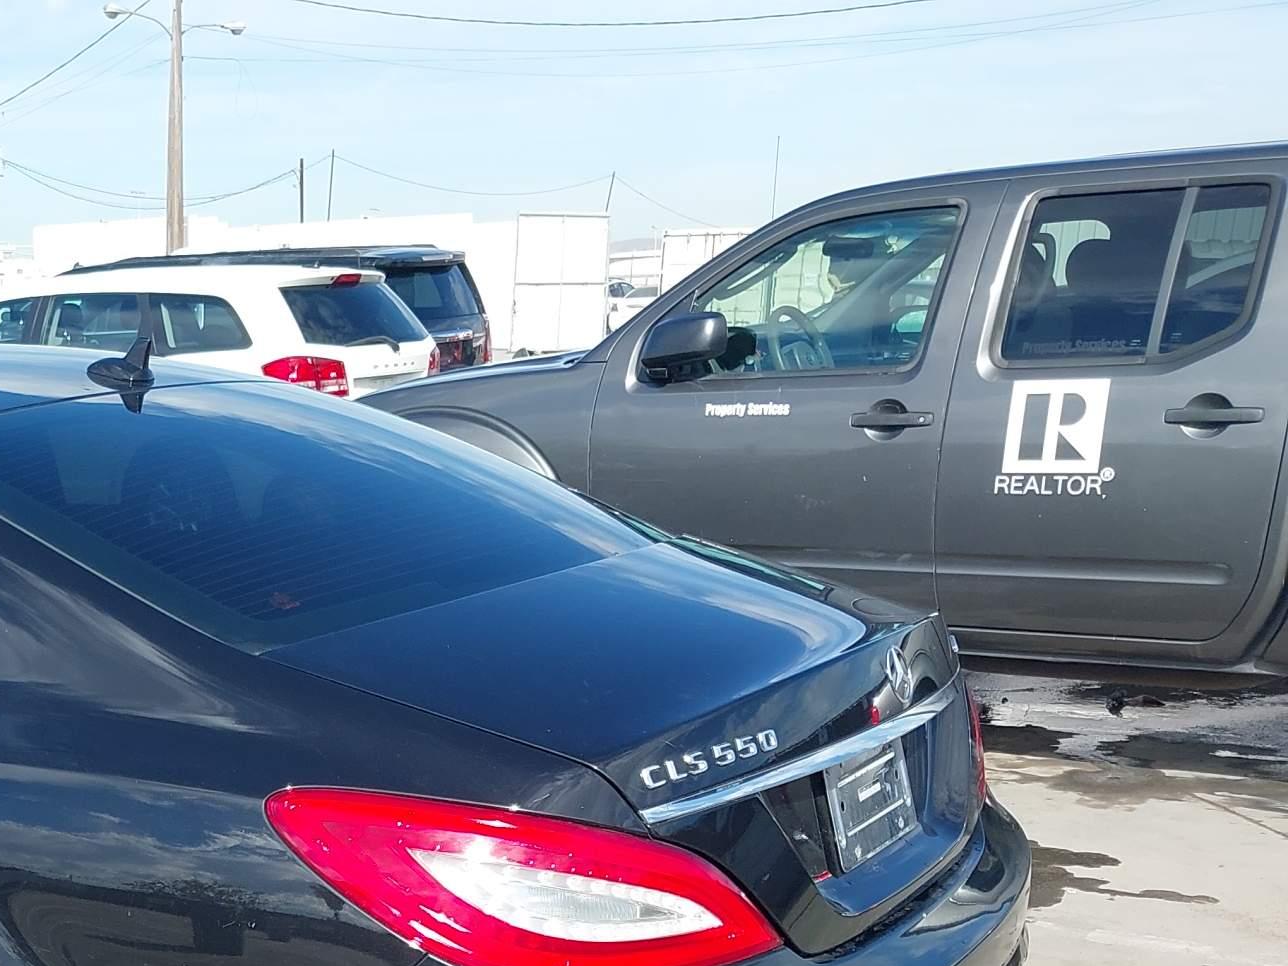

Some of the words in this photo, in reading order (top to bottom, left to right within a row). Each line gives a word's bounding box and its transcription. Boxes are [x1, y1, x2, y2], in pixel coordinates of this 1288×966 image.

[705, 402, 746, 417] Property
[747, 401, 790, 416] Services
[639, 751, 709, 790] CLS
[711, 728, 779, 767] 550
